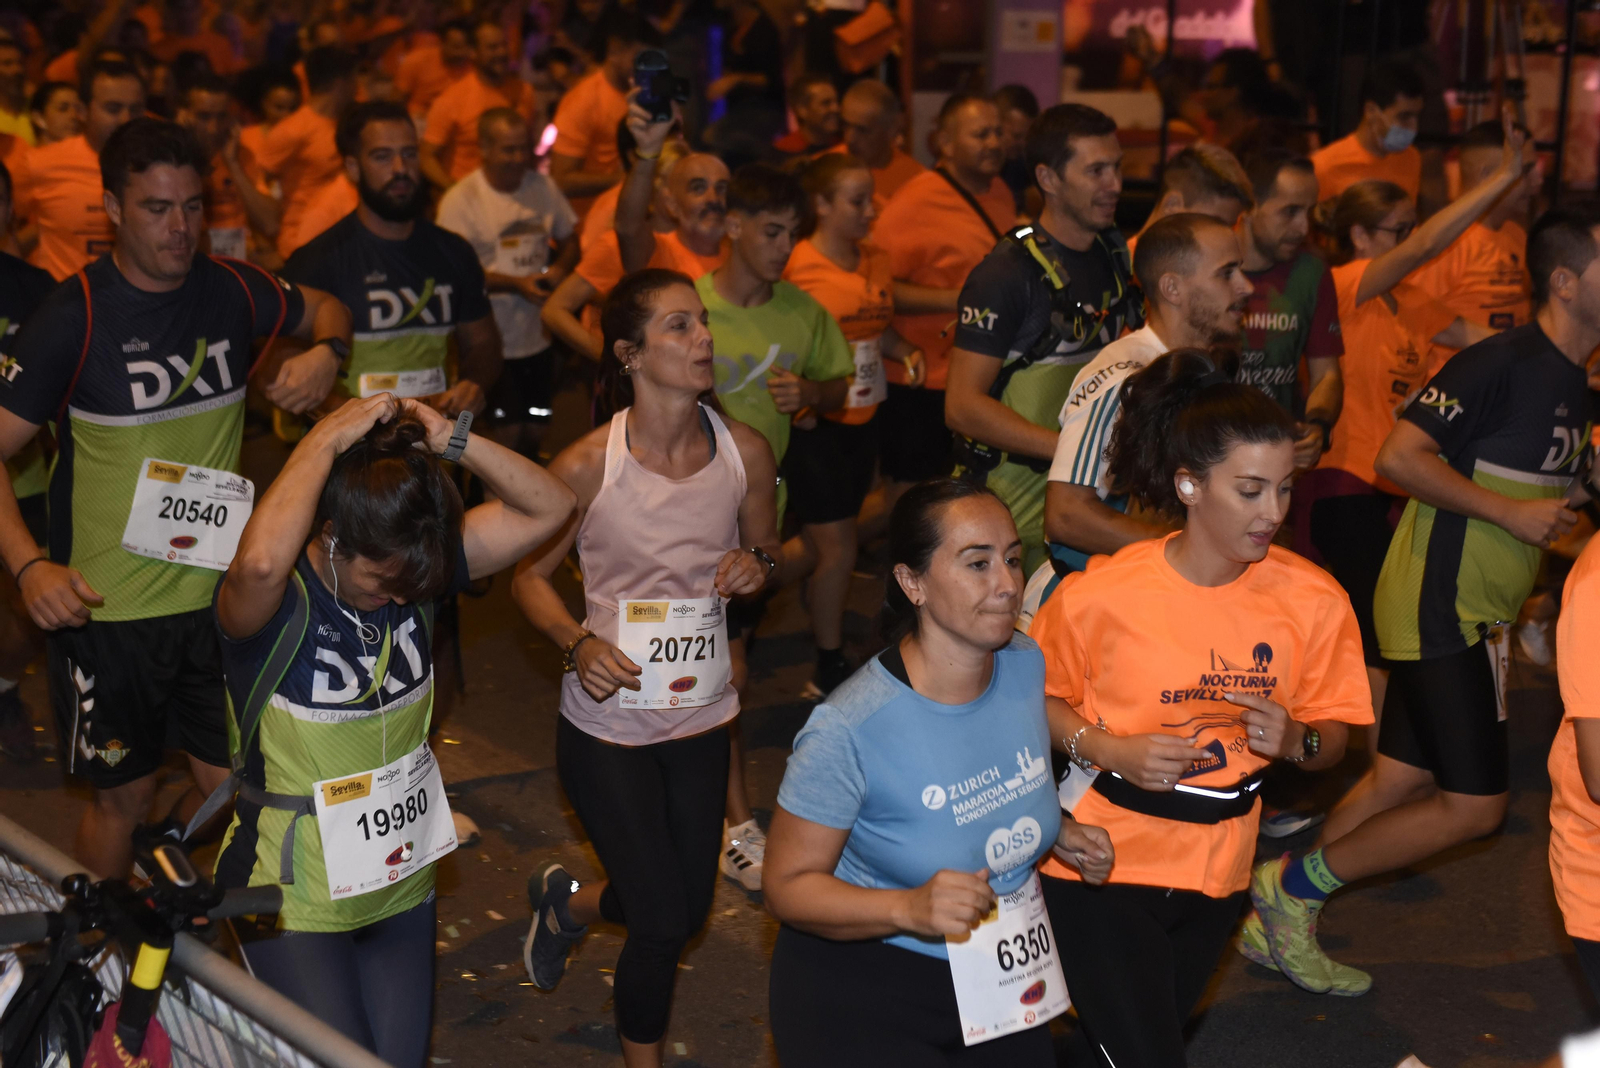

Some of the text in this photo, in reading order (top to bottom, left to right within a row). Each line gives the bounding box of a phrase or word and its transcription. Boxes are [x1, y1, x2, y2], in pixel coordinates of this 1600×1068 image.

[366, 278, 453, 330] DXT
[961, 305, 999, 331] DXT
[122, 341, 150, 353] HORIZON
[0, 352, 24, 383] XT
[126, 338, 234, 410] DXT
[1419, 386, 1464, 422] DXT
[158, 495, 228, 528] 20540
[311, 616, 424, 705] DXT
[648, 634, 715, 663] 20721
[1199, 674, 1277, 688] NOCTURNA
[947, 765, 1001, 801] ZURICH
[952, 784, 1006, 816] MARATOIA
[356, 787, 428, 842] 19980
[955, 791, 1018, 827] DONOSTIA/SAN
[992, 827, 1035, 861] D/SS
[997, 922, 1050, 972] 6350
[998, 974, 1026, 988] AGUSTINA
